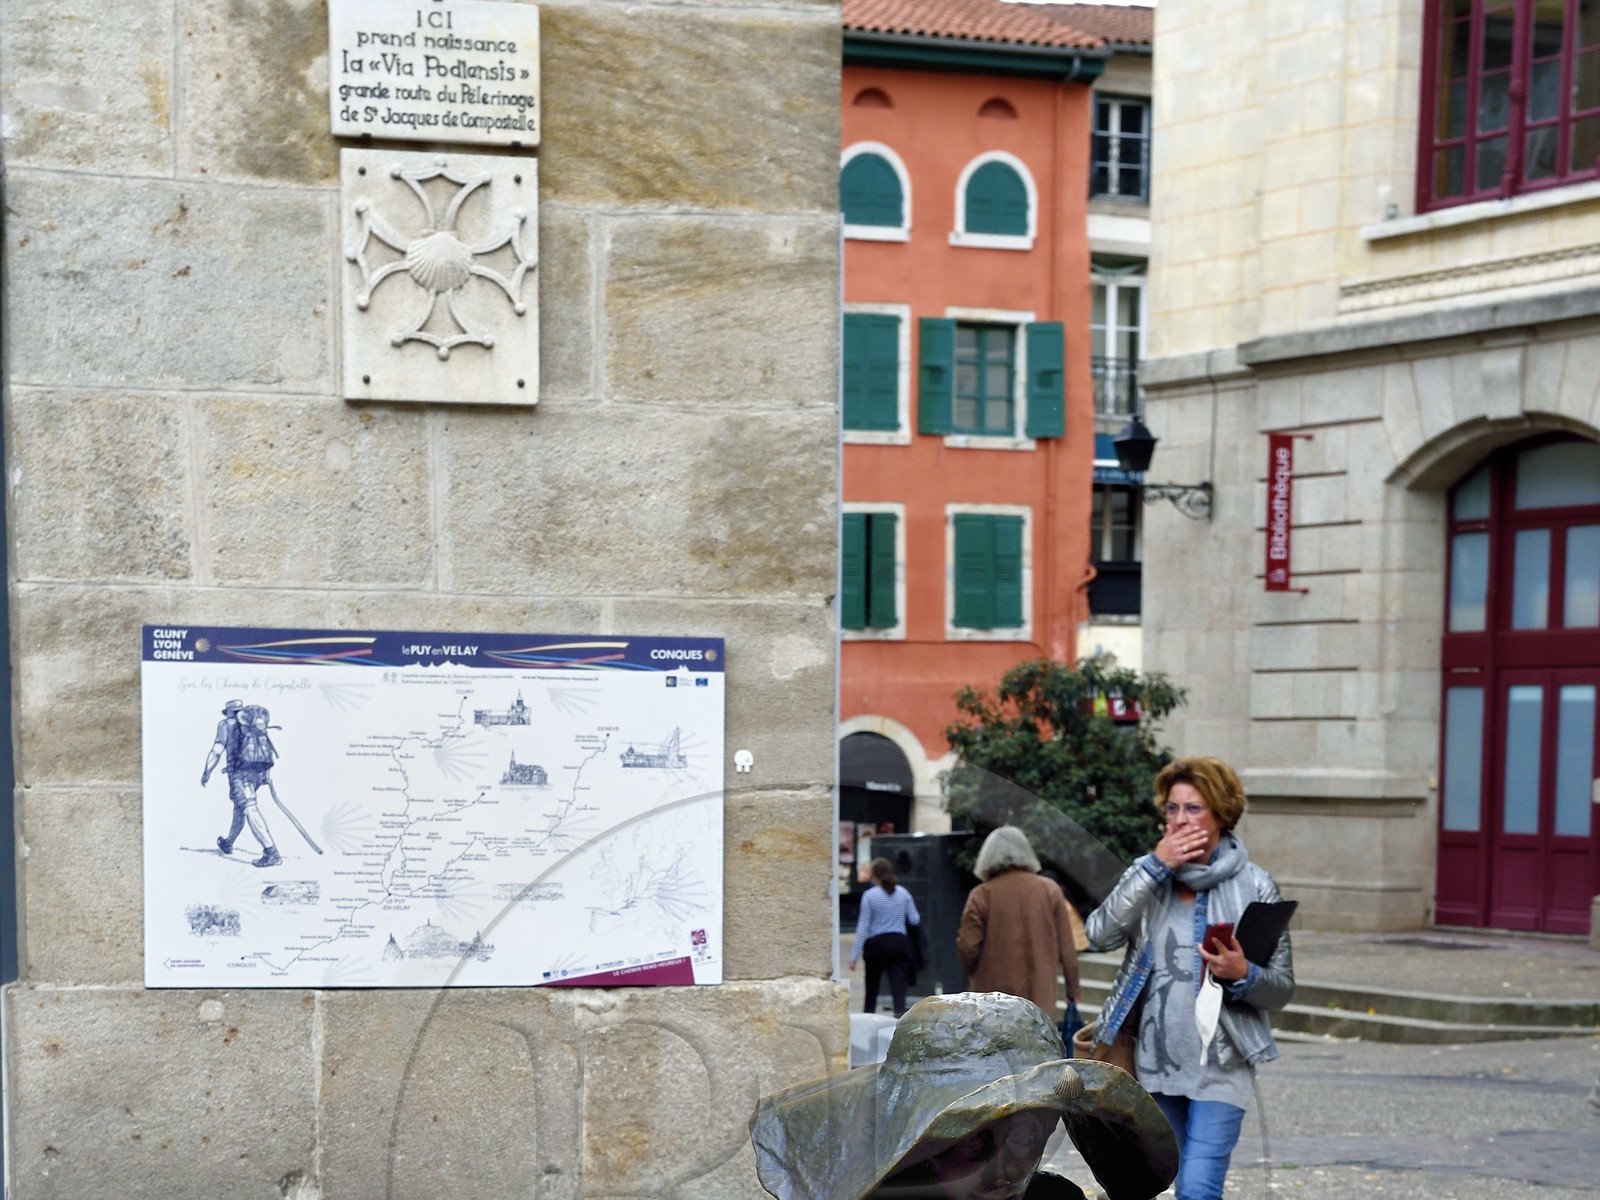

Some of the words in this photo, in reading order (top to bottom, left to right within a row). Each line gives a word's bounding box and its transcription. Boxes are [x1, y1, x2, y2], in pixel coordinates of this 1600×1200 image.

[416, 10, 452, 29] ICI
[357, 32, 416, 47] prend
[424, 34, 517, 53] naissance
[342, 49, 363, 73] la
[339, 82, 390, 102] grande
[396, 85, 431, 100] route
[437, 85, 457, 103] du
[340, 106, 358, 122] de
[381, 107, 438, 130] Jacques
[442, 110, 458, 127] de
[460, 112, 536, 134] Compostelle
[1270, 447, 1290, 560] Bibliothèque
[153, 629, 188, 639] CLUNY
[153, 639, 182, 649] LYON
[153, 649, 194, 660] GENÈVE
[650, 649, 703, 660] CONQUES
